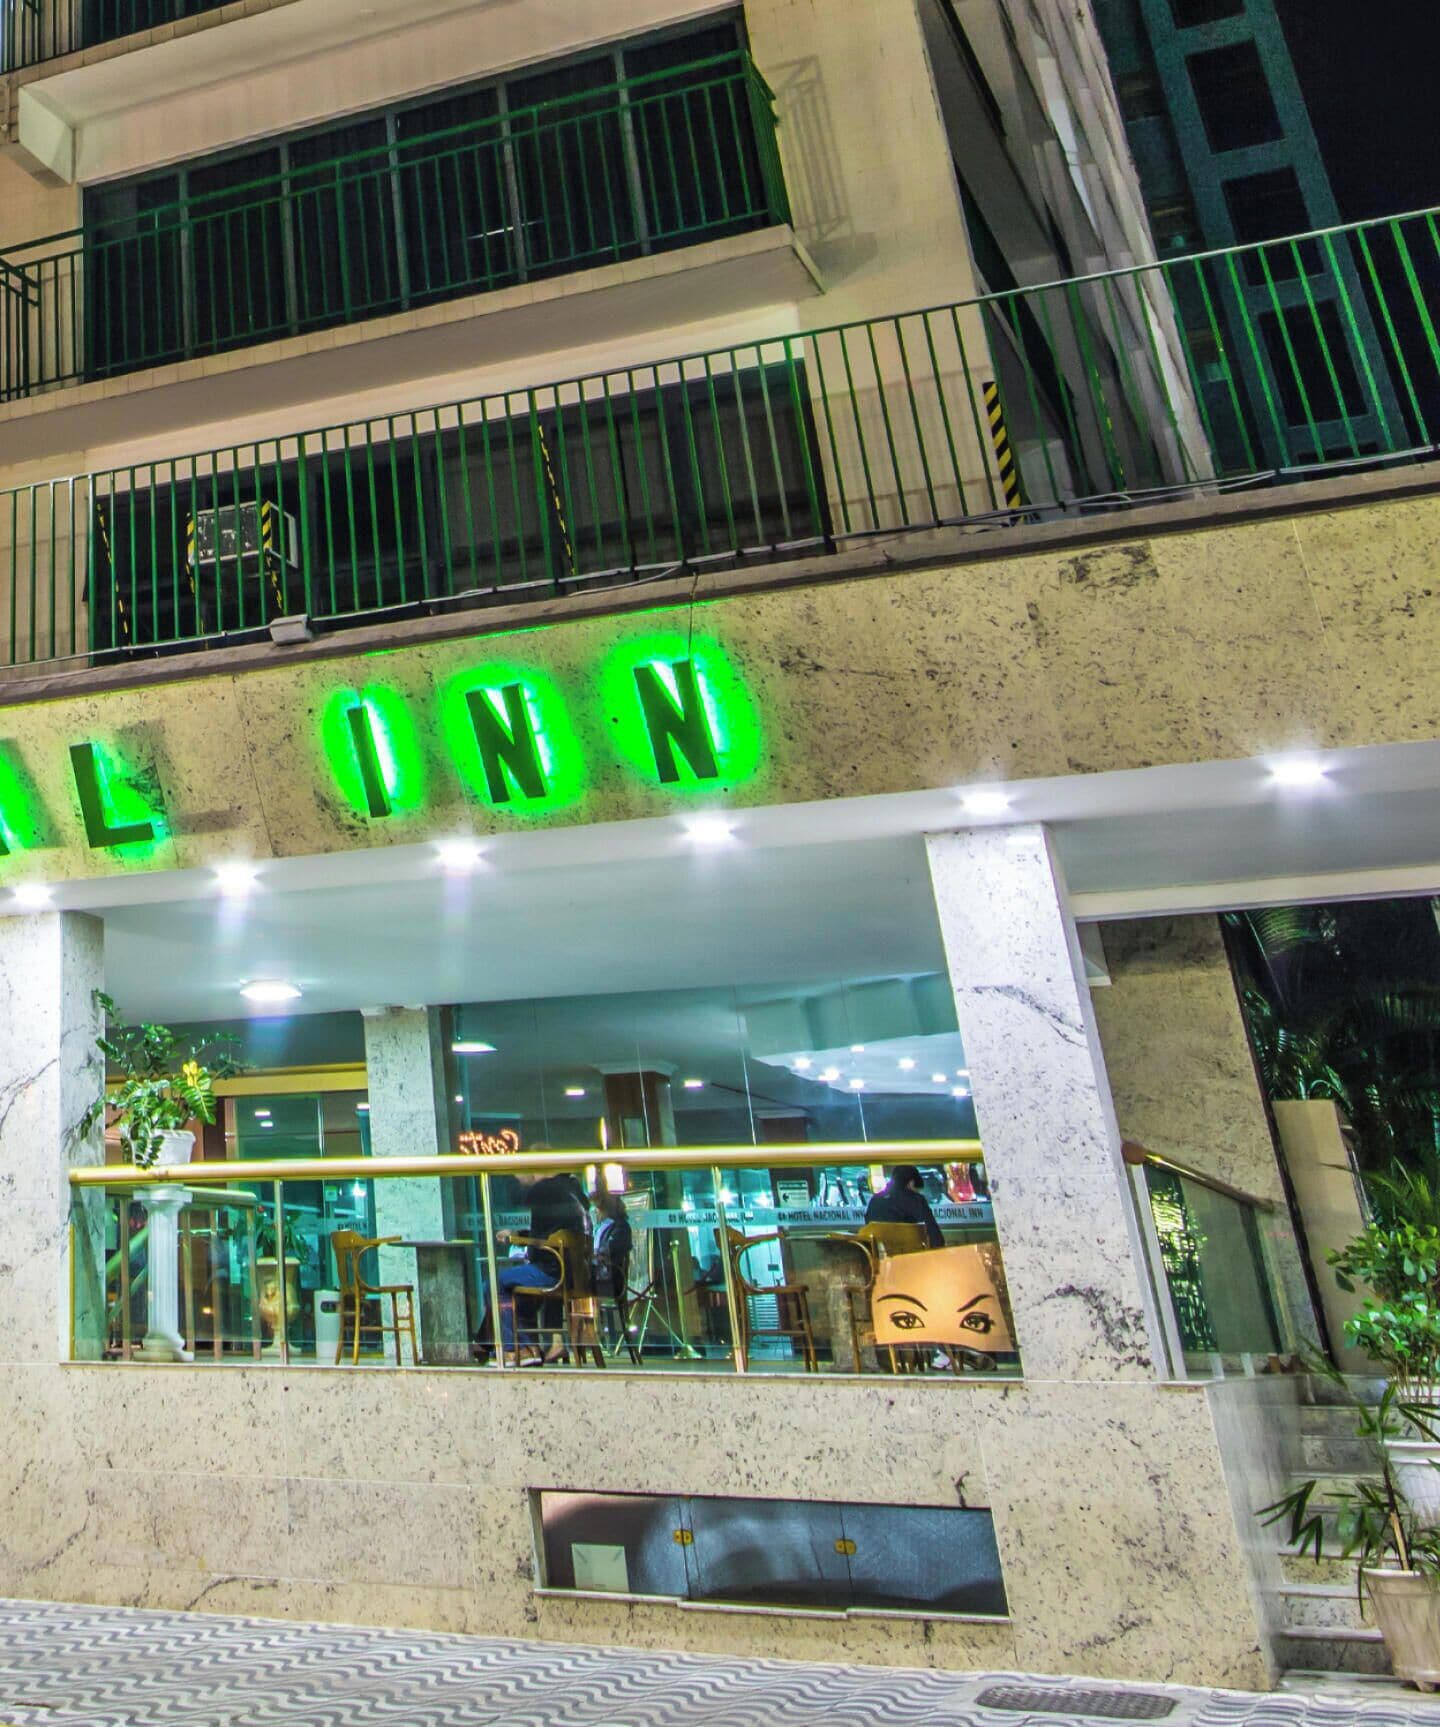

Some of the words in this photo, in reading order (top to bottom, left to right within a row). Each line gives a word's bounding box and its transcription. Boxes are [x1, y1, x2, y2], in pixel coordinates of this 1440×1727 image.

[347, 659, 720, 818] INN
[788, 1210, 812, 1221] HOTEL
[813, 1209, 850, 1221] NACIONAL
